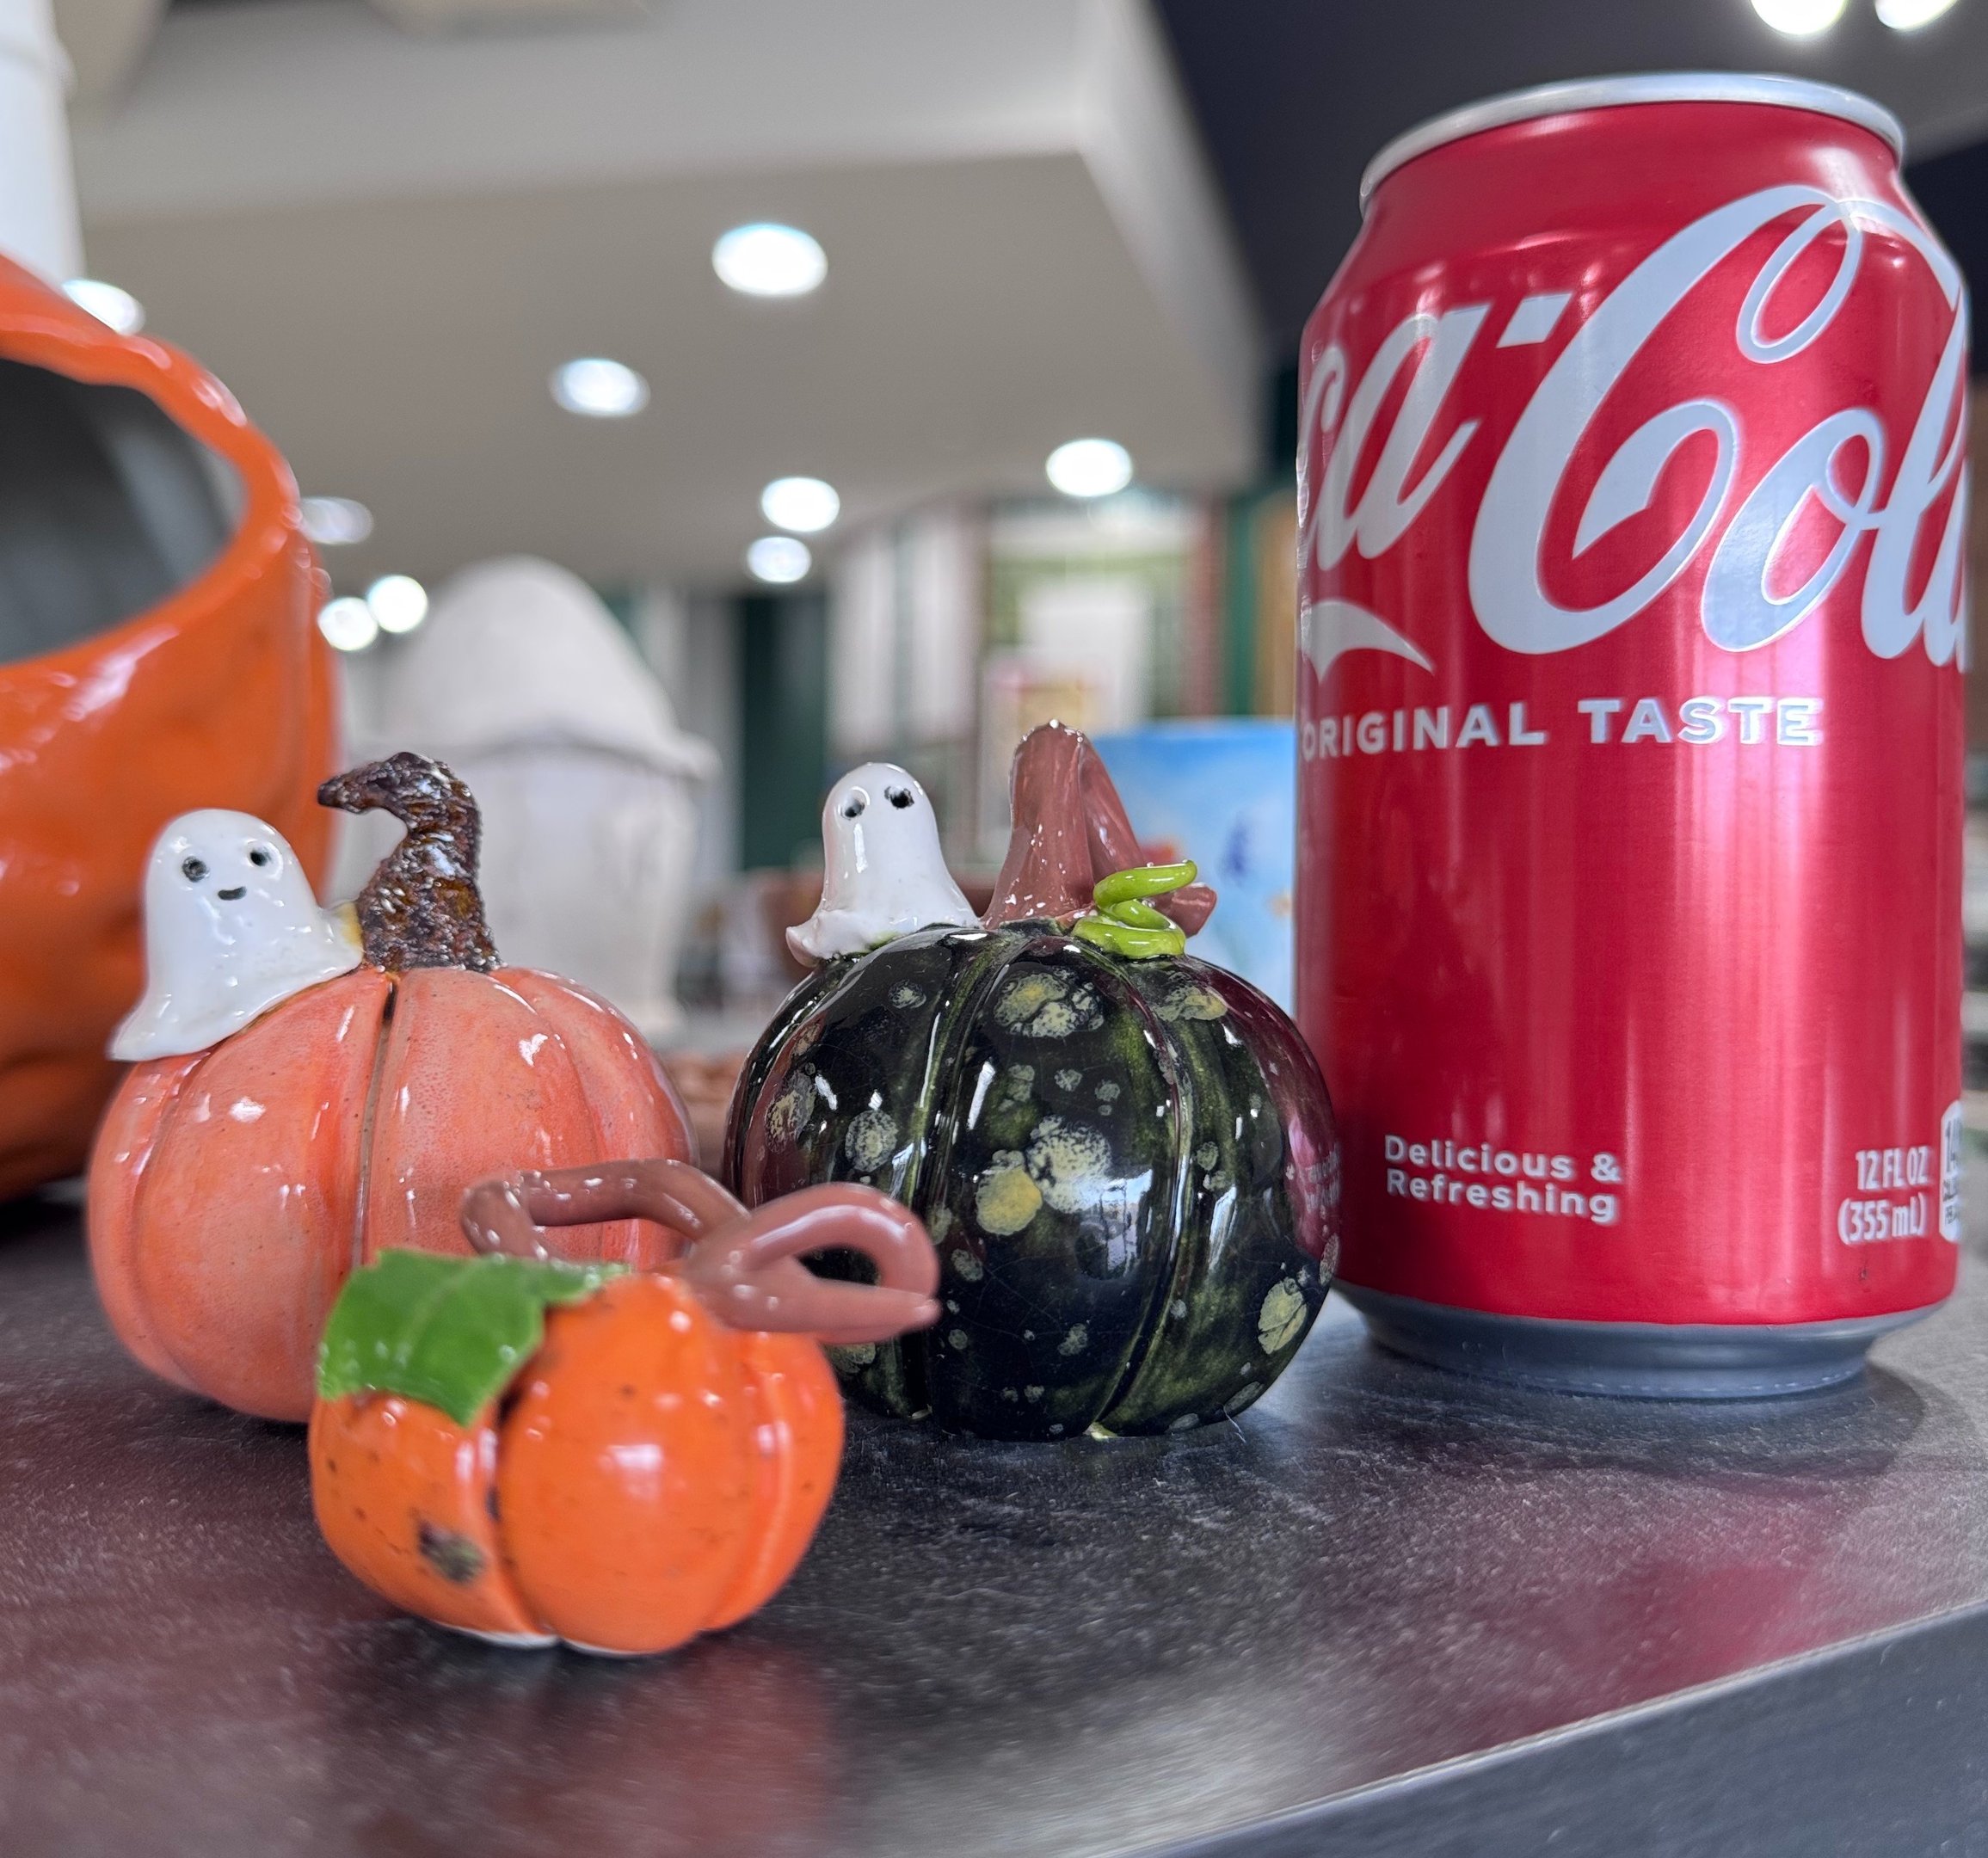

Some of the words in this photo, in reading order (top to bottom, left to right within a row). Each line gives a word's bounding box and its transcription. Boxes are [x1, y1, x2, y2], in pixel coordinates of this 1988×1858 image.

[1301, 701, 1548, 762] ORIGINAL
[1578, 696, 1825, 746] TASTE
[1383, 1134, 1575, 1180] Delicious
[1590, 1150, 1623, 1183] &
[1855, 1149, 1881, 1190] 12
[1882, 1147, 1905, 1189] FL
[1906, 1144, 1930, 1186] OZ
[1386, 1168, 1618, 1225] Refreshing
[1837, 1197, 1890, 1246] (355
[1892, 1191, 1928, 1238] mL)
